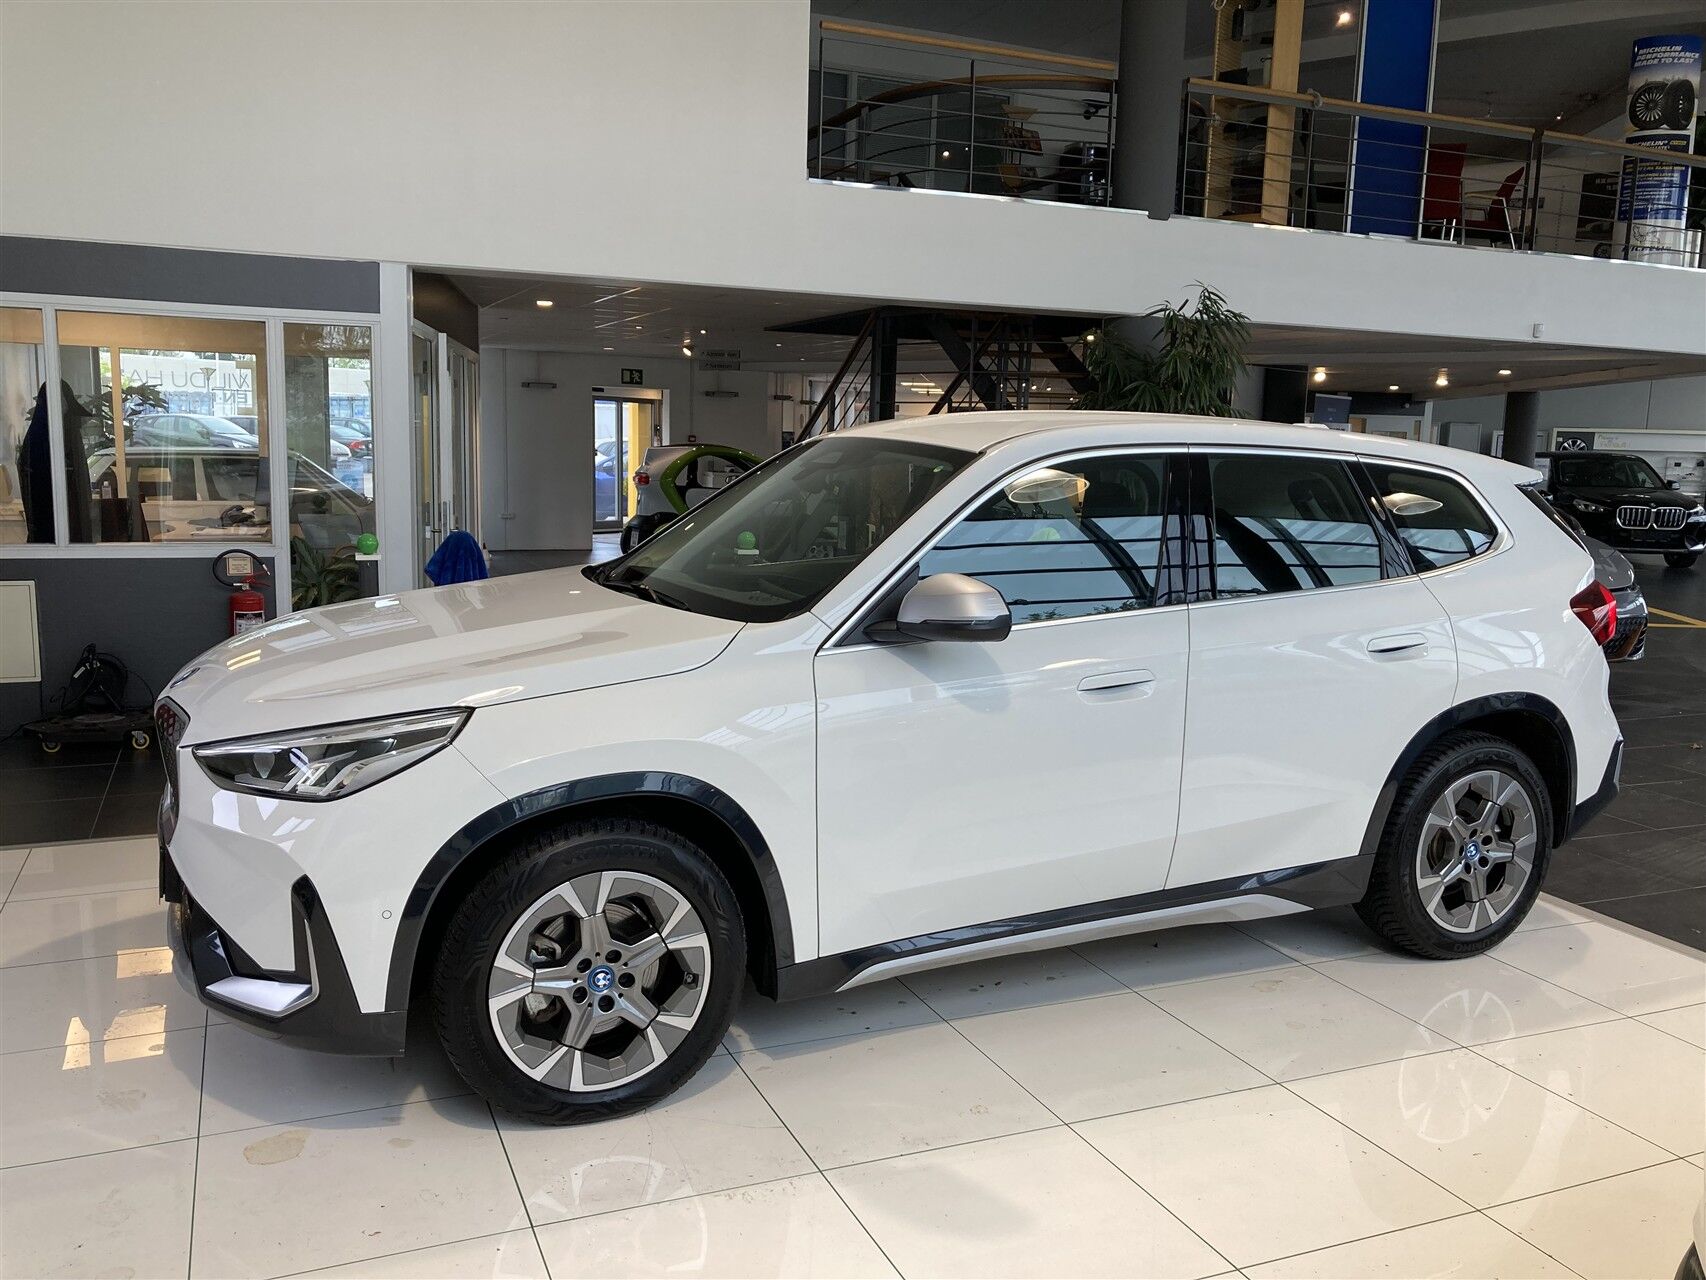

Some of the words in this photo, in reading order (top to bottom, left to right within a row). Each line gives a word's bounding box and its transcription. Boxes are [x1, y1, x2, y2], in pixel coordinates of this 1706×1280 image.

[1638, 46, 1683, 55] MICHELIN
[1636, 52, 1700, 61] PERFORMANCE
[1634, 59, 1660, 67] MADE
